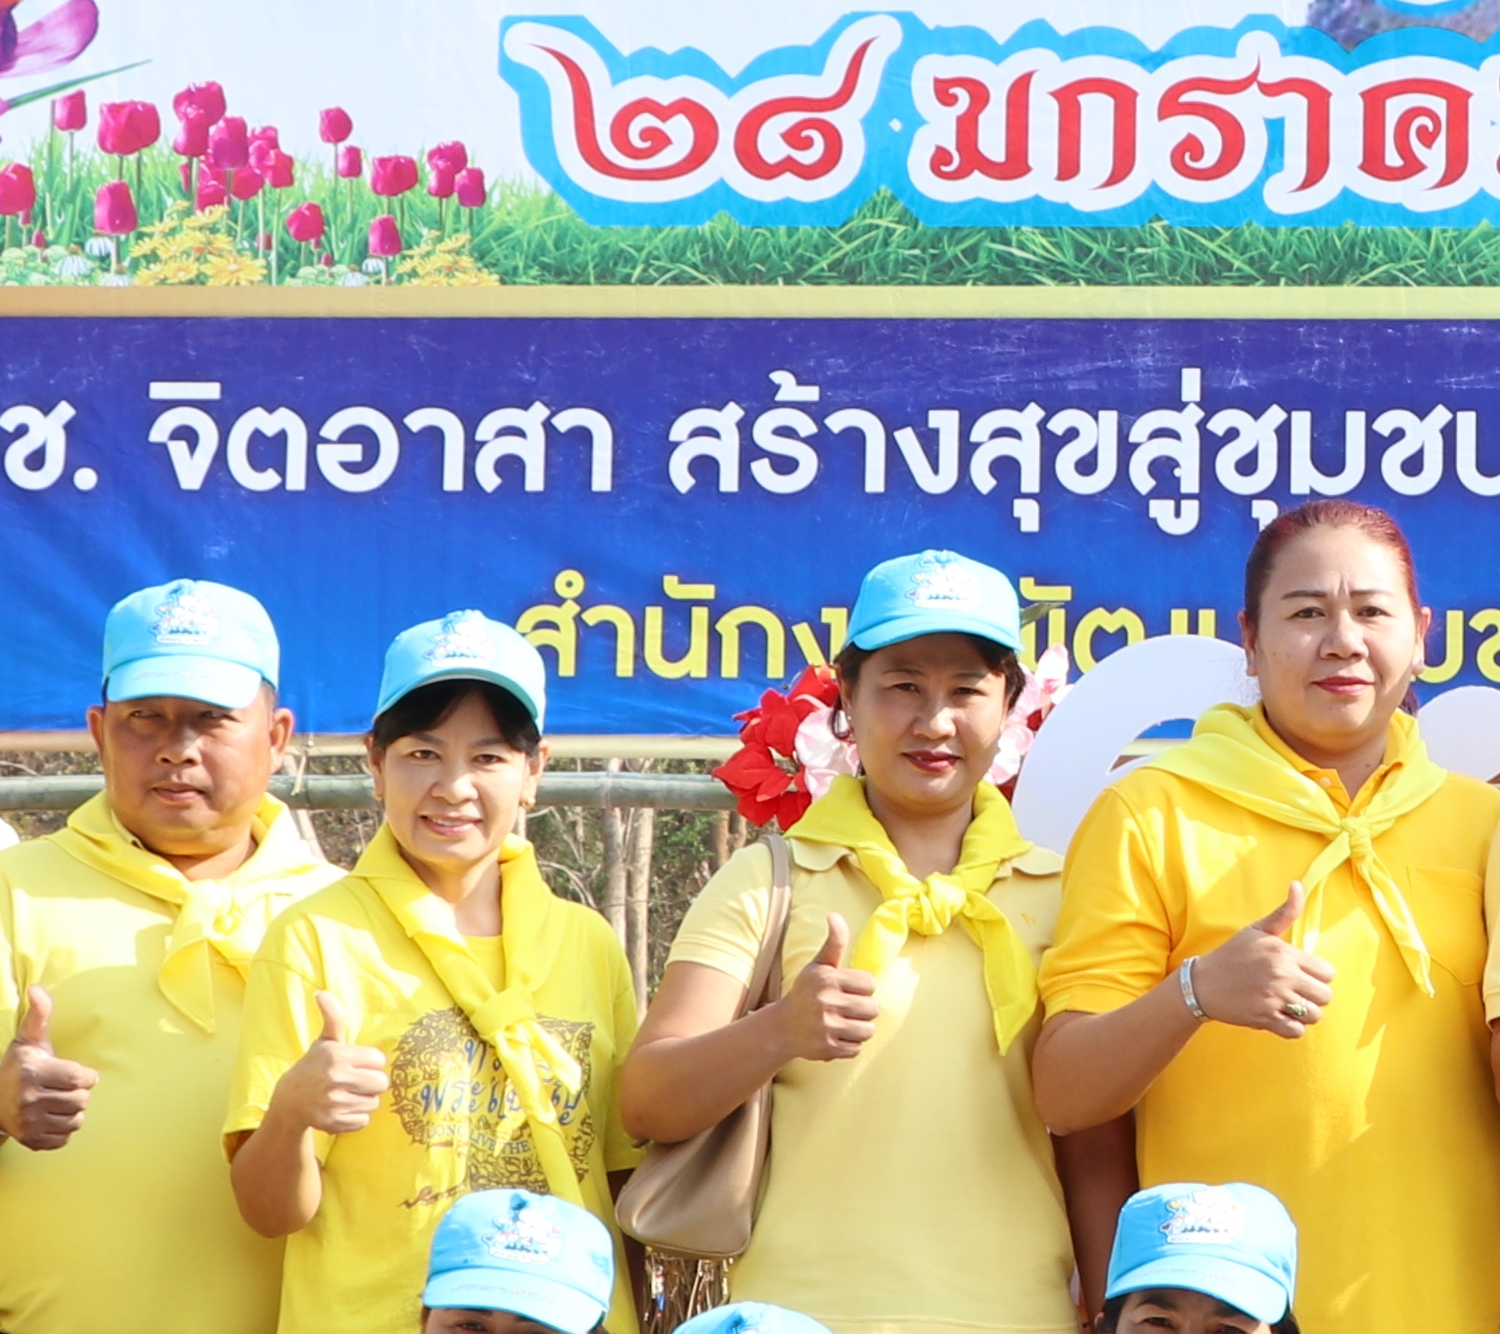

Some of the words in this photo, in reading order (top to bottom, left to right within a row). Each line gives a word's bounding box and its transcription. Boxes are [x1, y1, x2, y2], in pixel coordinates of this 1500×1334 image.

[543, 37, 878, 183] ๒๘
[147, 379, 614, 495] จิตอาสา
[426, 1123, 469, 1141] LONG
[470, 1132, 499, 1153] LIVE
